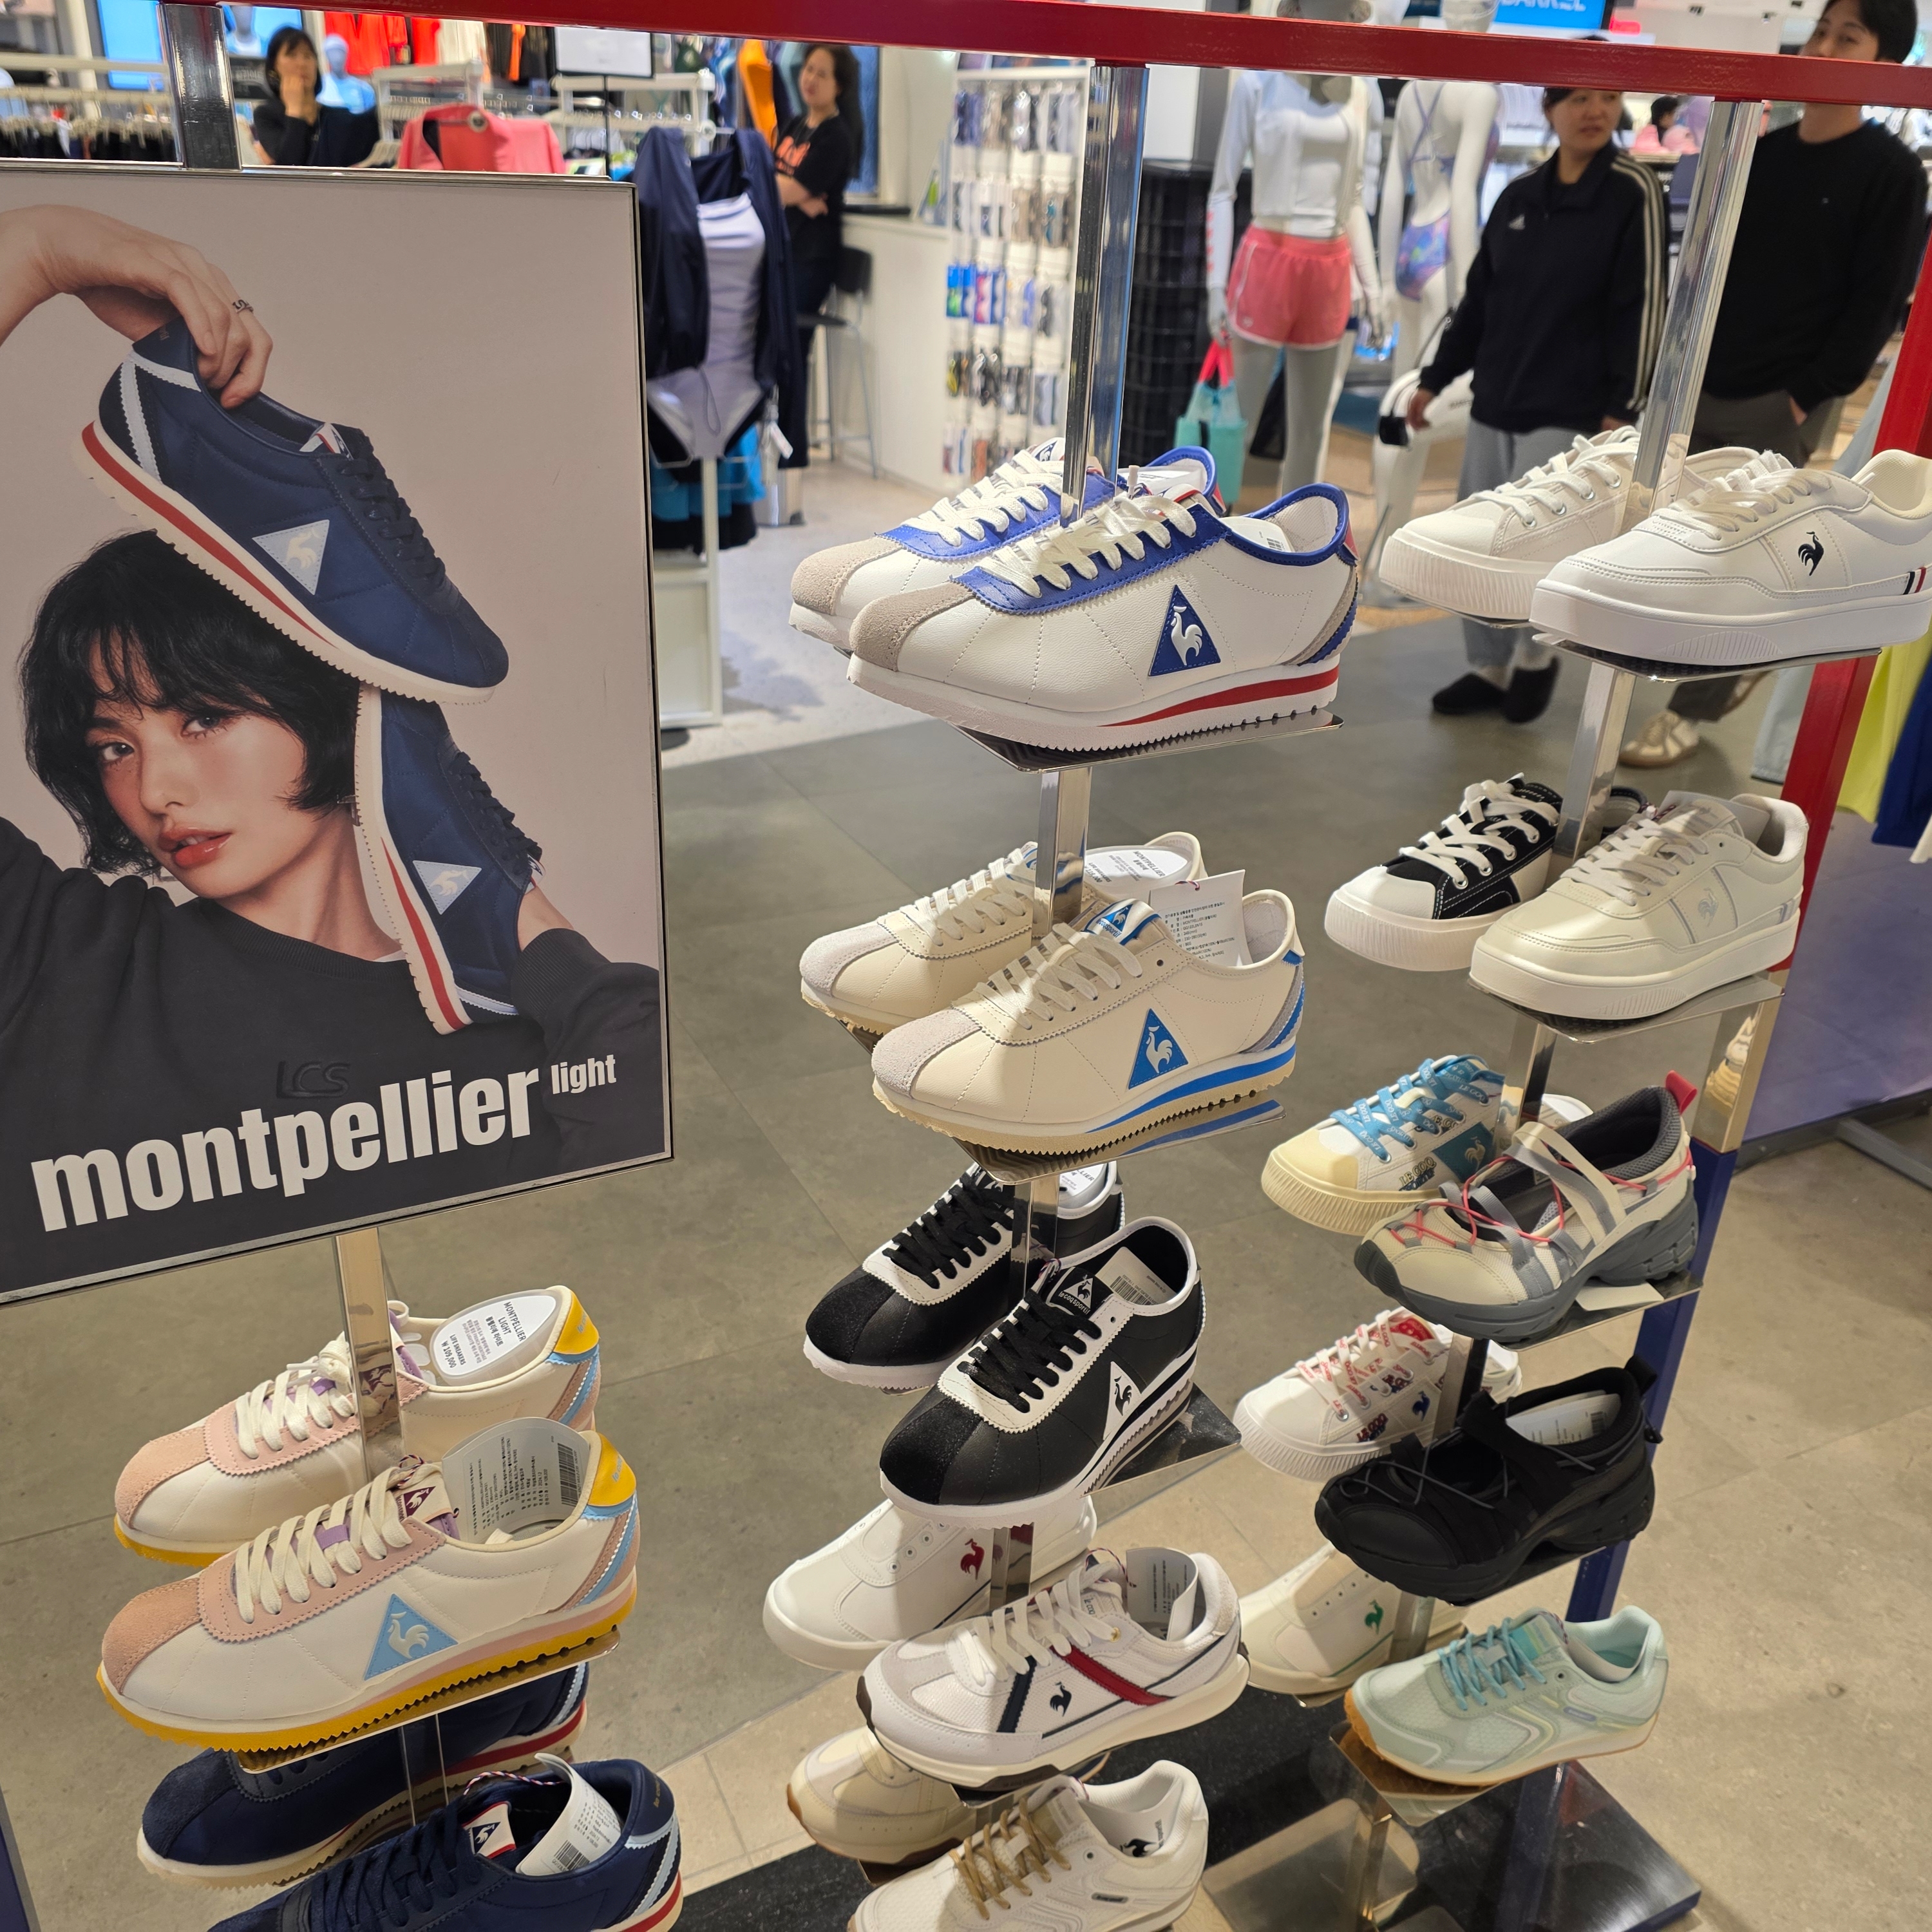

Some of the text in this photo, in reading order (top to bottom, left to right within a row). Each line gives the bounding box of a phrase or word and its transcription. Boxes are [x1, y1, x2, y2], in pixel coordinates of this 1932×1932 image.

[30, 1054, 616, 1232] montpellier light
[486, 1316, 504, 1347] 몽펠리에 라이트
[498, 1317, 511, 1335] LIGHT
[504, 1302, 526, 1341] MONTPELLIER
[441, 1347, 457, 1368] 109,000
[450, 1334, 467, 1365] LIFE SNEAKERS
